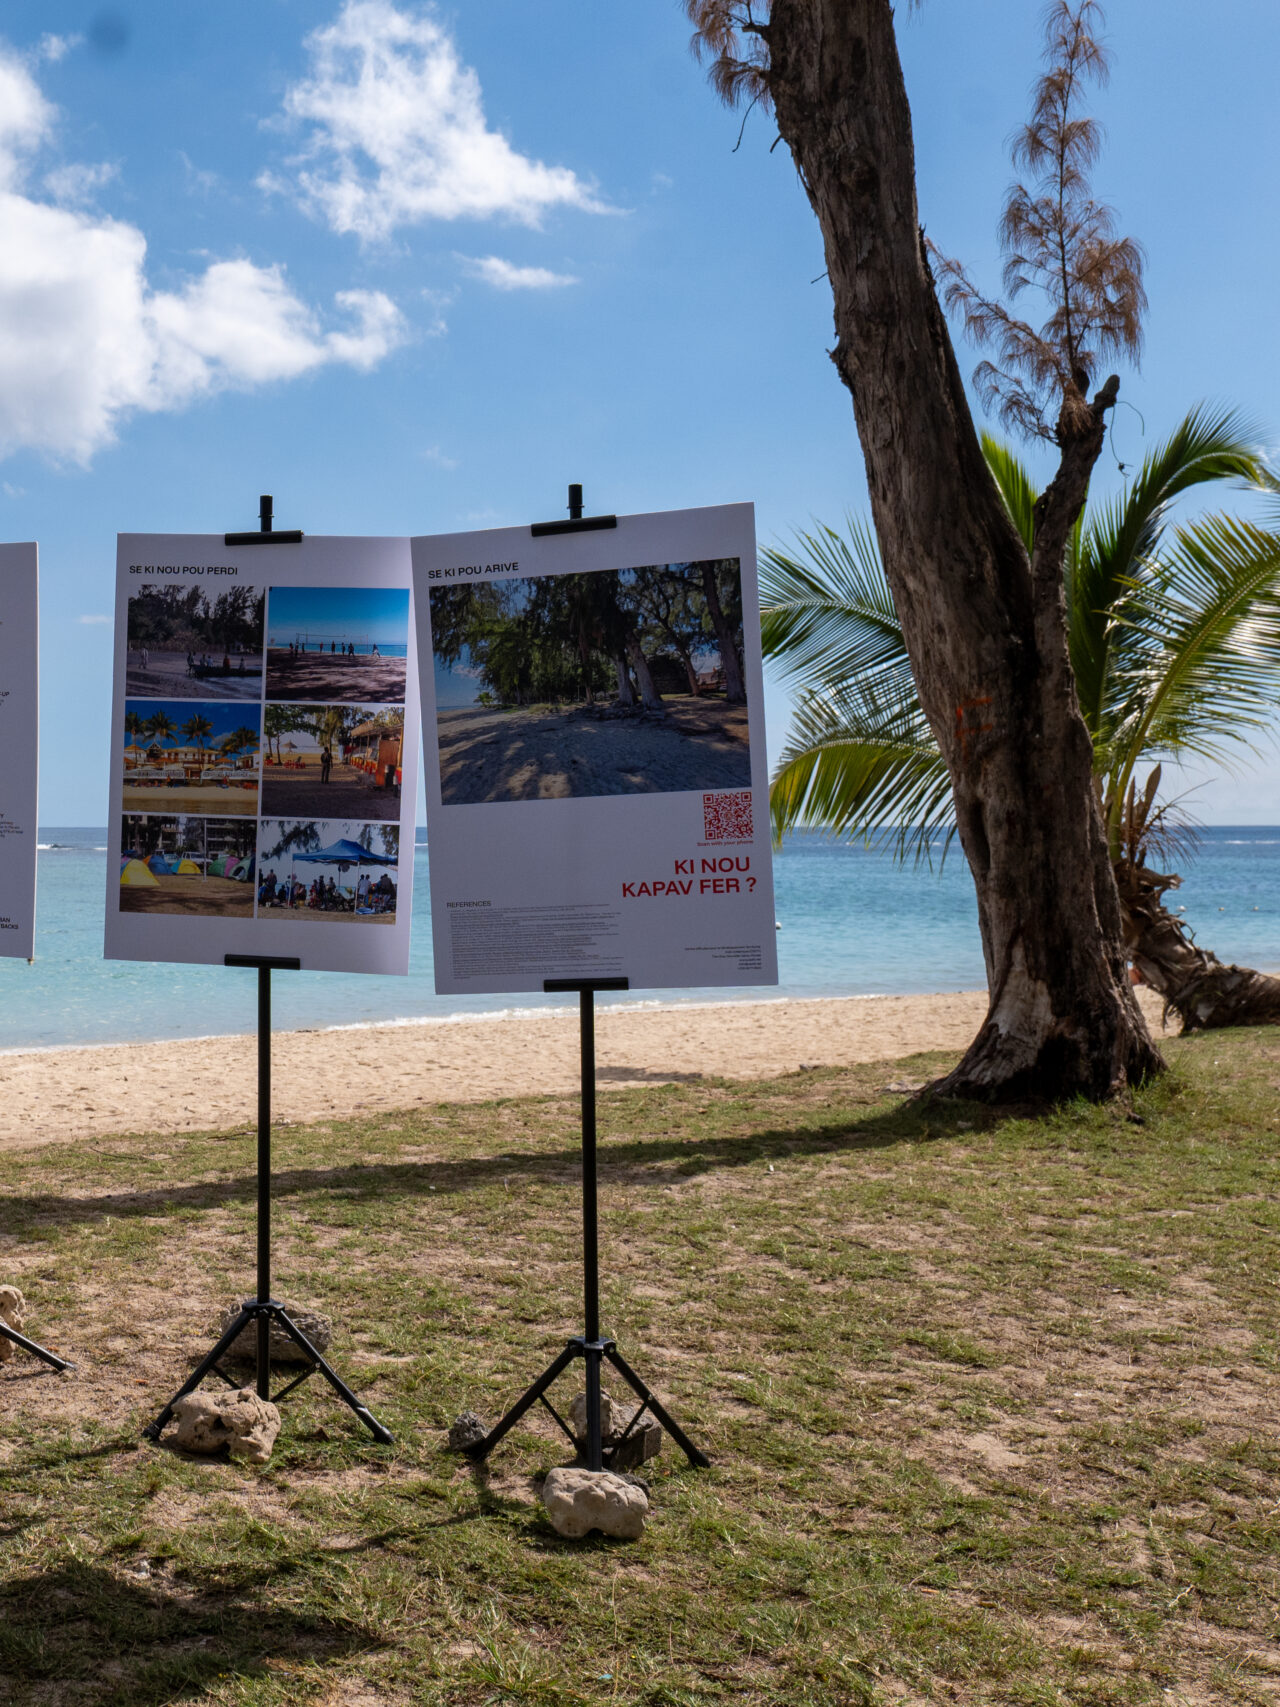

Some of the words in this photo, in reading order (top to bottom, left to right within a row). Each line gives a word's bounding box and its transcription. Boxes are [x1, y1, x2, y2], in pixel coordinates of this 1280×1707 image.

[129, 565, 142, 574] SE
[144, 565, 154, 574] KI
[157, 566, 180, 575] NOU
[182, 566, 205, 575] POU
[207, 566, 238, 575] PERDI
[428, 569, 442, 579] SE
[444, 568, 455, 577] KI
[458, 565, 482, 576] POU
[484, 562, 519, 574] ARIVE
[674, 859, 695, 875] KI
[701, 856, 750, 873] NOU
[622, 880, 693, 898] KAPAV
[699, 878, 740, 895] FER
[745, 876, 757, 893] ?
[446, 900, 491, 908] REFERENCES
